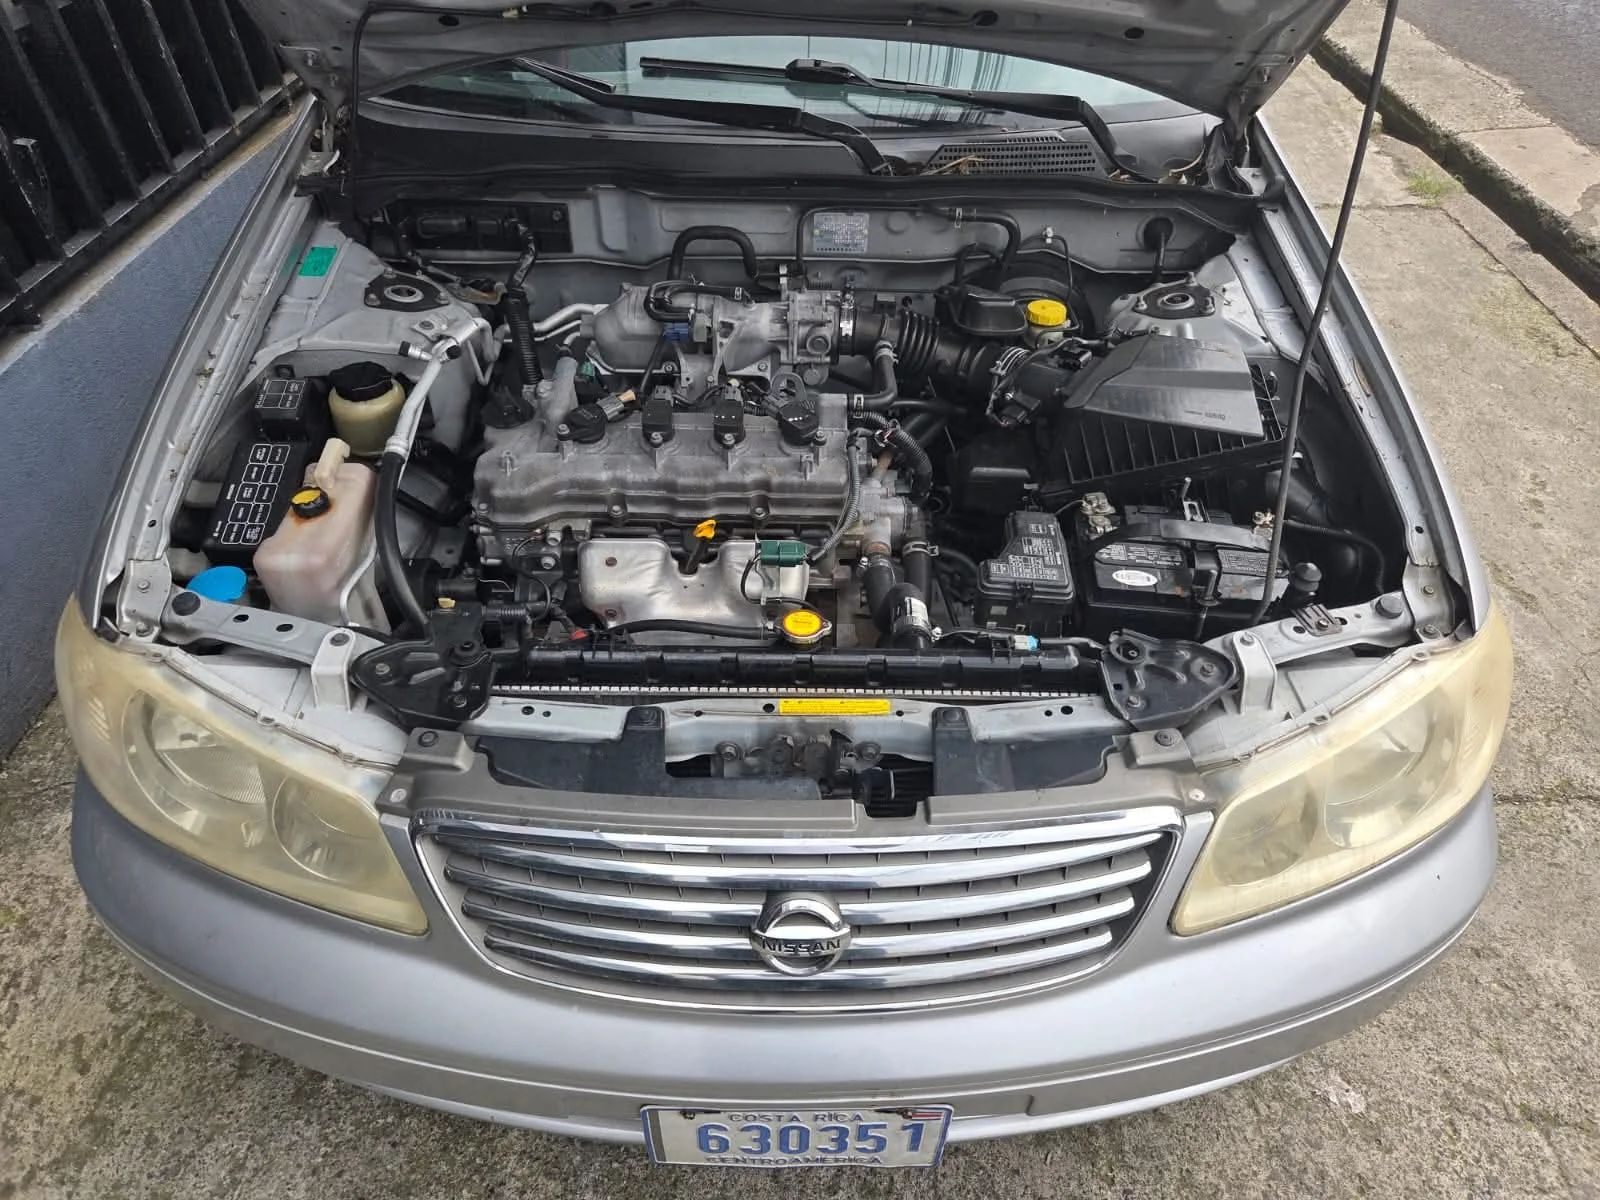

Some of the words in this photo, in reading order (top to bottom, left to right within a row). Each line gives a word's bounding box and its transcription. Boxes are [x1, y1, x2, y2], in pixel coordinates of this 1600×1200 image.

[761, 938, 841, 955] NISSAN
[728, 1111, 802, 1123] COSTA
[813, 1111, 865, 1123] RICA
[697, 1121, 926, 1155] 630351
[705, 1155, 884, 1166] CENTROAMERICA
